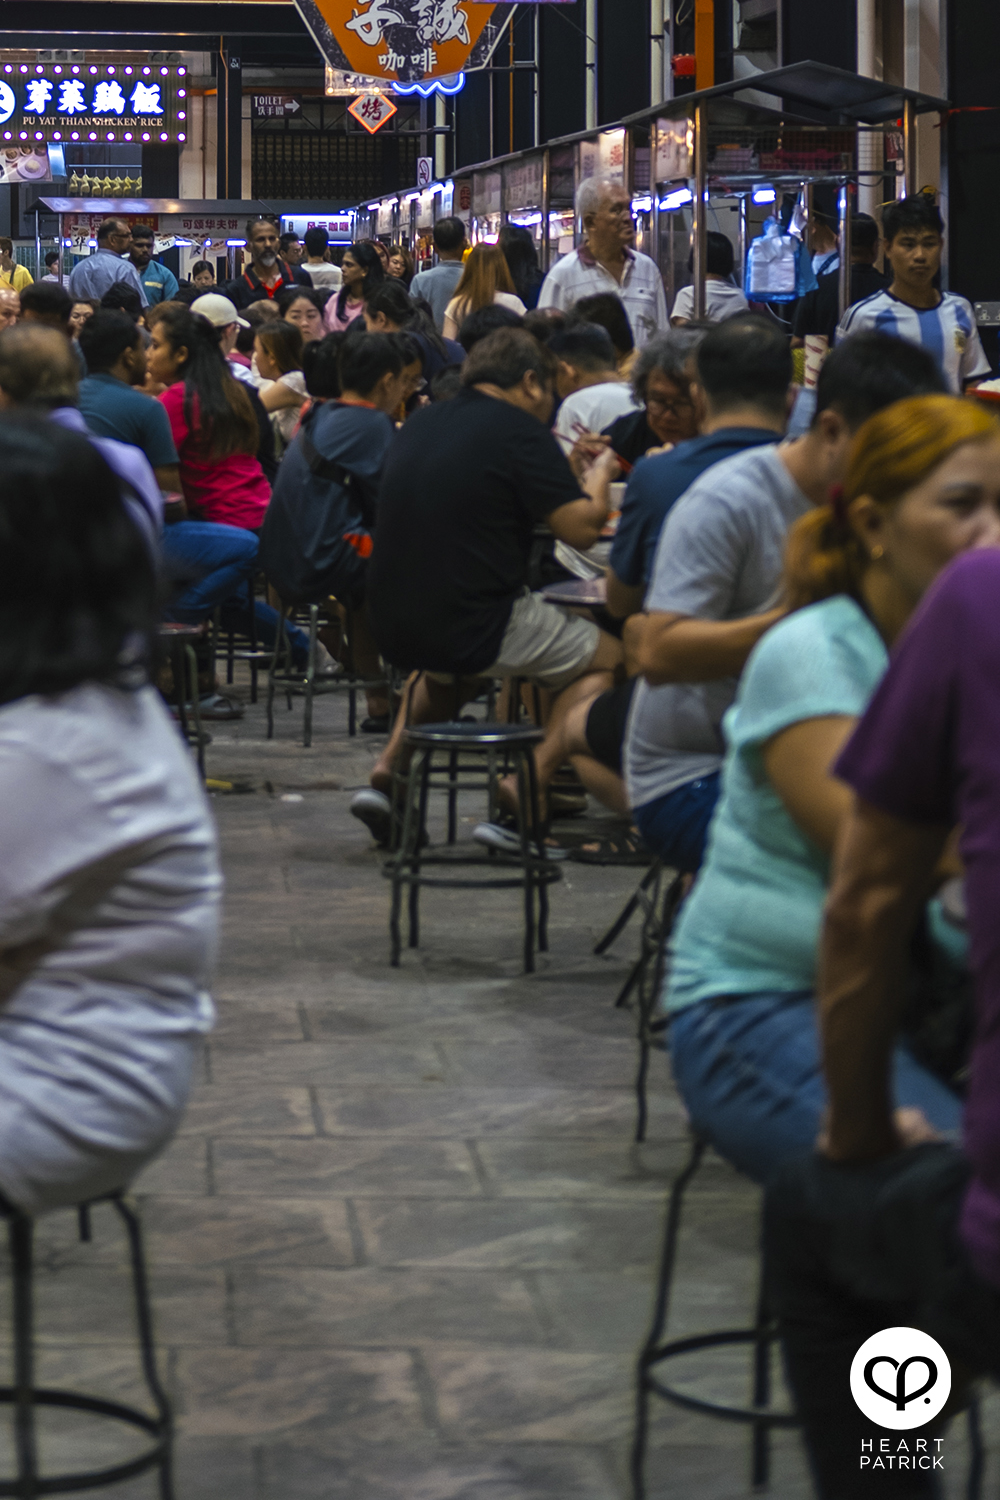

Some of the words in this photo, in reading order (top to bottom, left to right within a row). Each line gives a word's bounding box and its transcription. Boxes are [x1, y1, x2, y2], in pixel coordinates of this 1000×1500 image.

[377, 47, 439, 75] 咖啡
[253, 95, 284, 107] TOILET
[22, 116, 36, 127] PU
[39, 116, 57, 127] YAT
[59, 116, 92, 127] THIAN
[93, 116, 137, 127] CHICKEN
[140, 117, 164, 127] RICE
